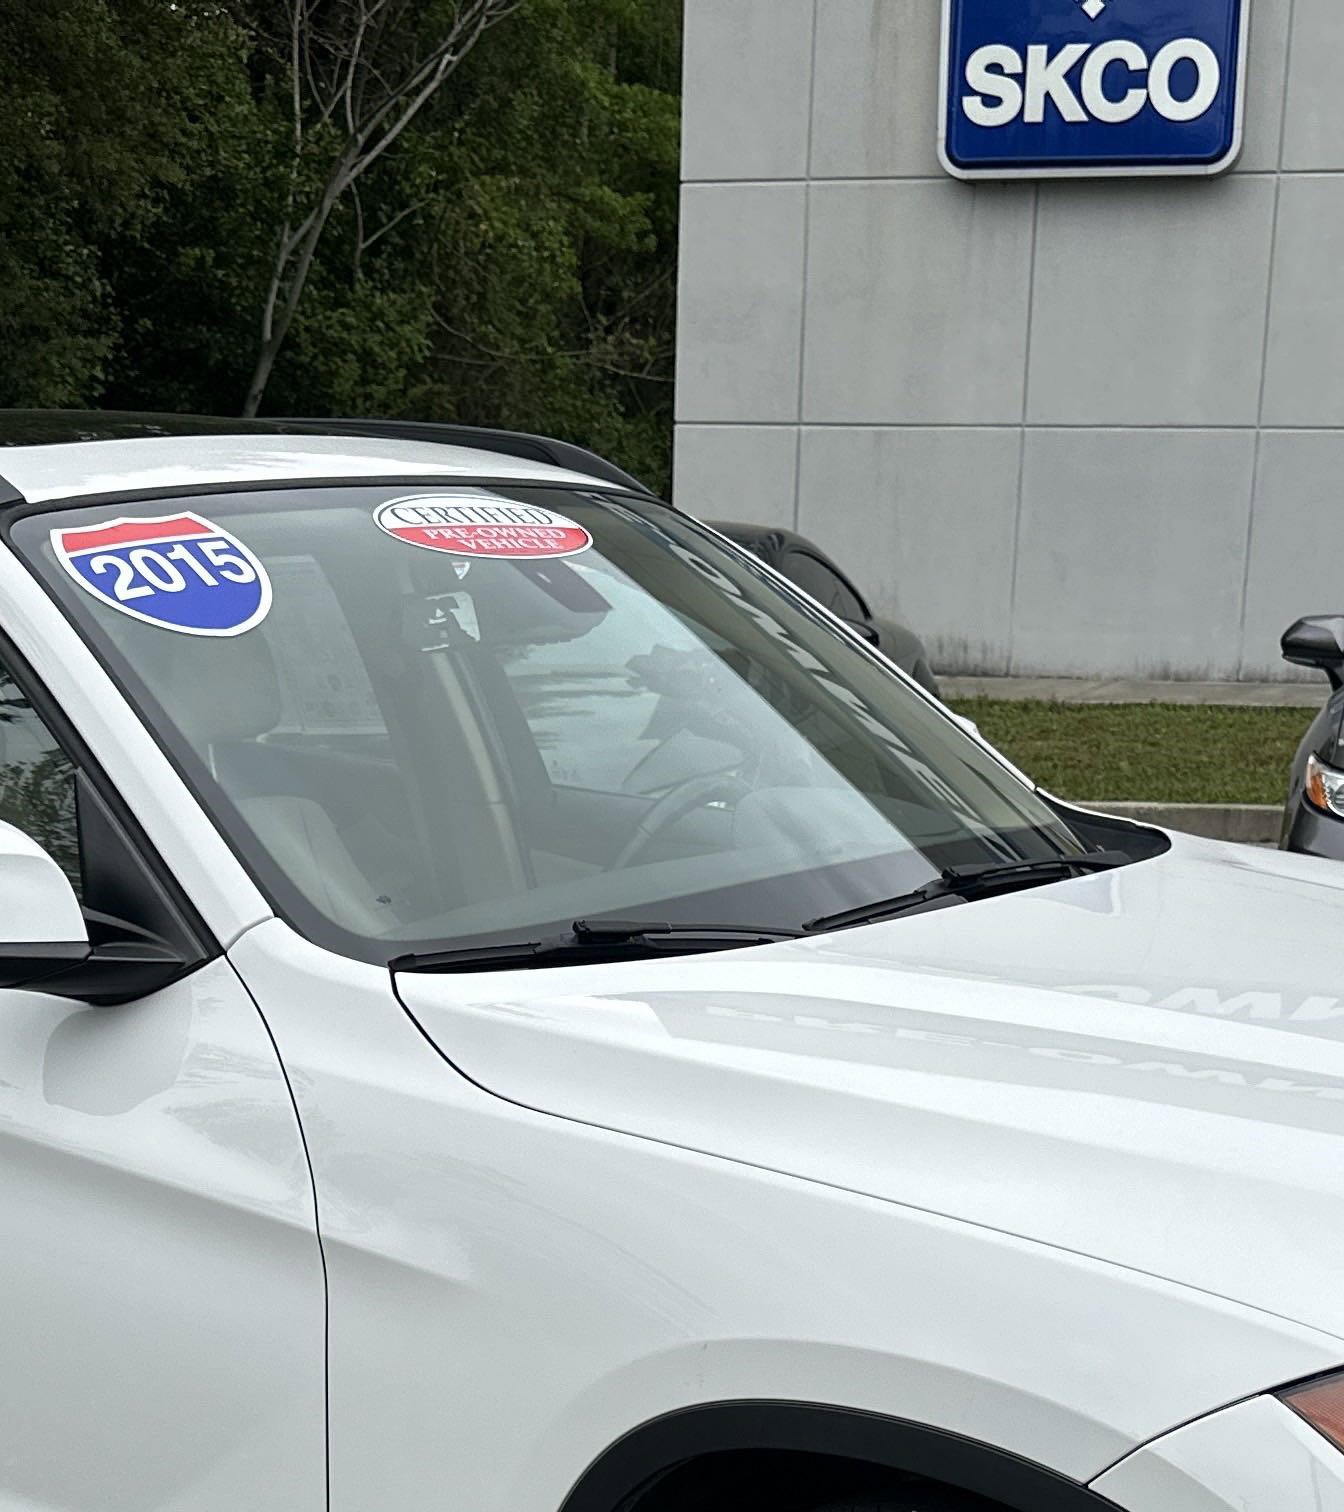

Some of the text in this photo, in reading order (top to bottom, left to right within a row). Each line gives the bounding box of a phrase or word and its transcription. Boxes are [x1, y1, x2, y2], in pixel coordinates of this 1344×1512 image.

[962, 38, 1220, 127] SKCO
[390, 506, 553, 525] CERTIFIED
[422, 527, 567, 541] PRE-OWNED
[456, 537, 562, 551] VEHICLE
[90, 538, 258, 602] 2015
